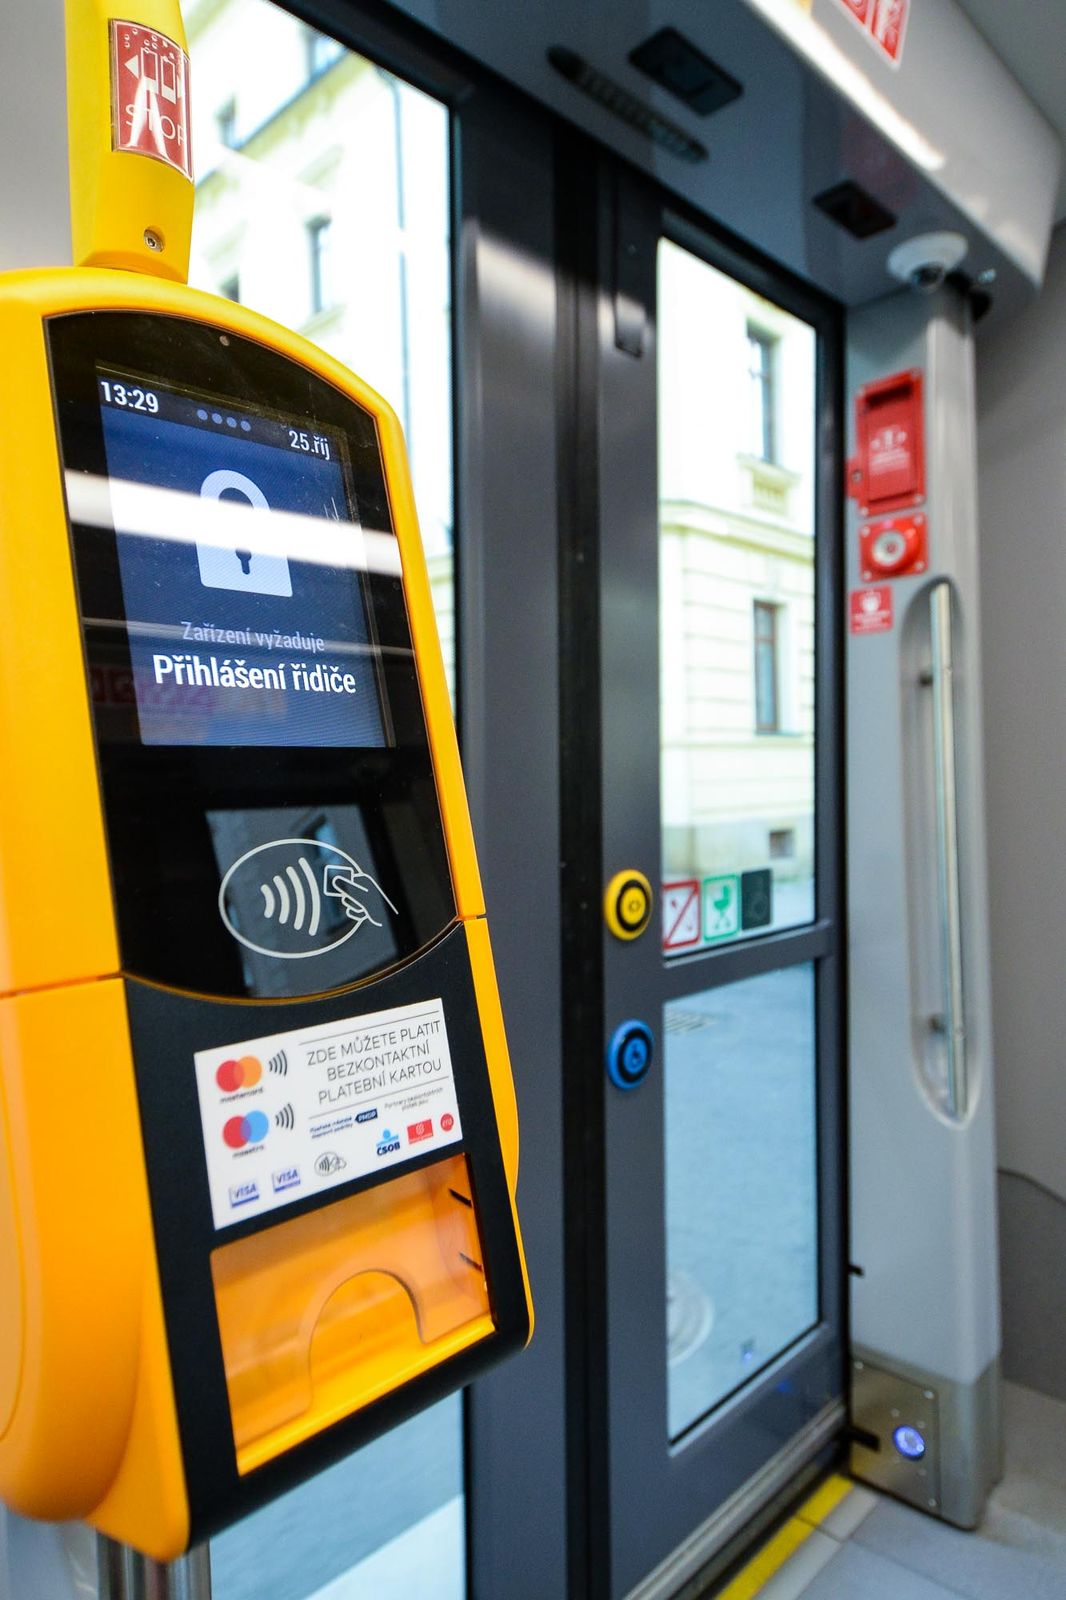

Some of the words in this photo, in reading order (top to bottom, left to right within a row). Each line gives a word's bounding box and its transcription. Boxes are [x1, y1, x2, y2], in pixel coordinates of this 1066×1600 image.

[101, 381, 159, 413] 13:29
[289, 430, 330, 460] 25.říj
[181, 621, 251, 645] Zařízení
[256, 629, 325, 653] vyžaduje
[153, 654, 287, 690] Přihlášení
[290, 663, 356, 694] řidiče
[306, 1046, 337, 1066] ZDE
[341, 1031, 397, 1057] MŮŽETE
[400, 1020, 441, 1041] PLATIT
[327, 1039, 430, 1082] BEZKONTAKTNÍ
[318, 1071, 386, 1105] PLATEBNÍ
[389, 1058, 442, 1085] KARTOU
[234, 1183, 257, 1199] VISA
[277, 1169, 299, 1184] VISA
